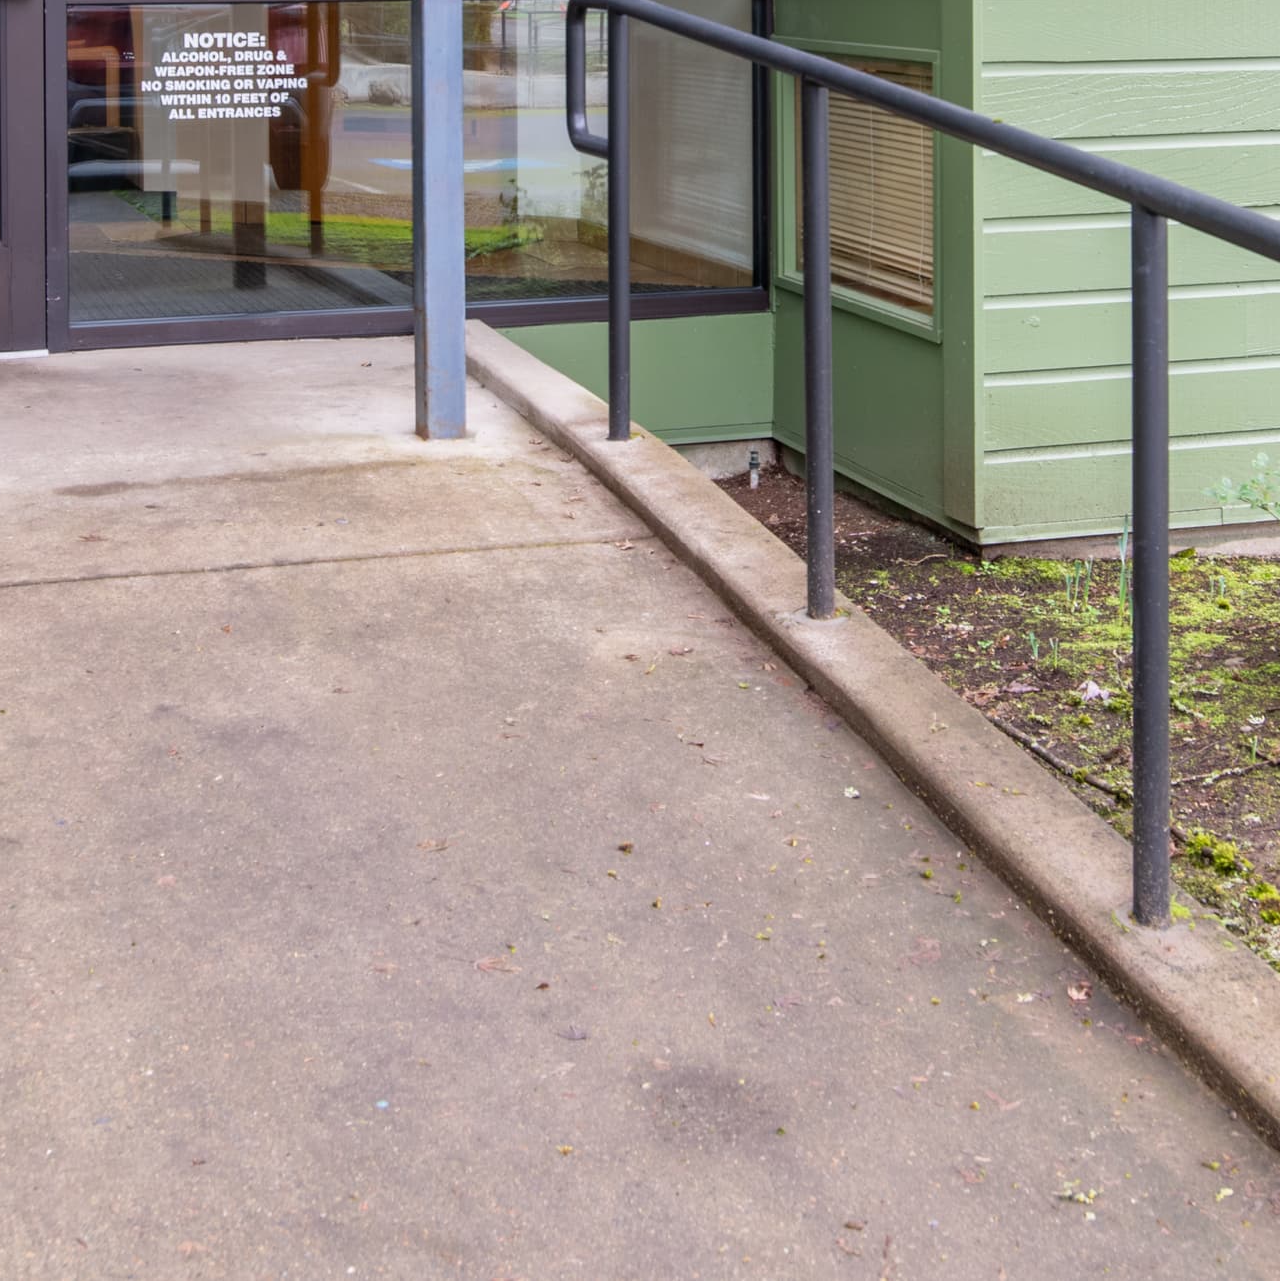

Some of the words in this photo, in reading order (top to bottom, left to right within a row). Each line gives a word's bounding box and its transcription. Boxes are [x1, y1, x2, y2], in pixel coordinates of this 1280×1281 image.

[184, 32, 266, 48] NOTICE:
[162, 51, 231, 64] ALCOHOL,
[234, 51, 273, 62] DRUG
[276, 50, 287, 61] &
[155, 65, 254, 77] WEAPON-FREE
[256, 64, 295, 75] ZONE
[141, 80, 162, 92] NO
[165, 79, 231, 91] SMOKING
[234, 79, 253, 90] OR
[256, 78, 308, 89] VAPING
[161, 93, 212, 105] WITHIN
[215, 93, 230, 104] 10
[233, 92, 268, 104] FEET
[270, 92, 289, 103] OF
[169, 108, 195, 120] ALL
[198, 106, 281, 119] ENTRANCES
